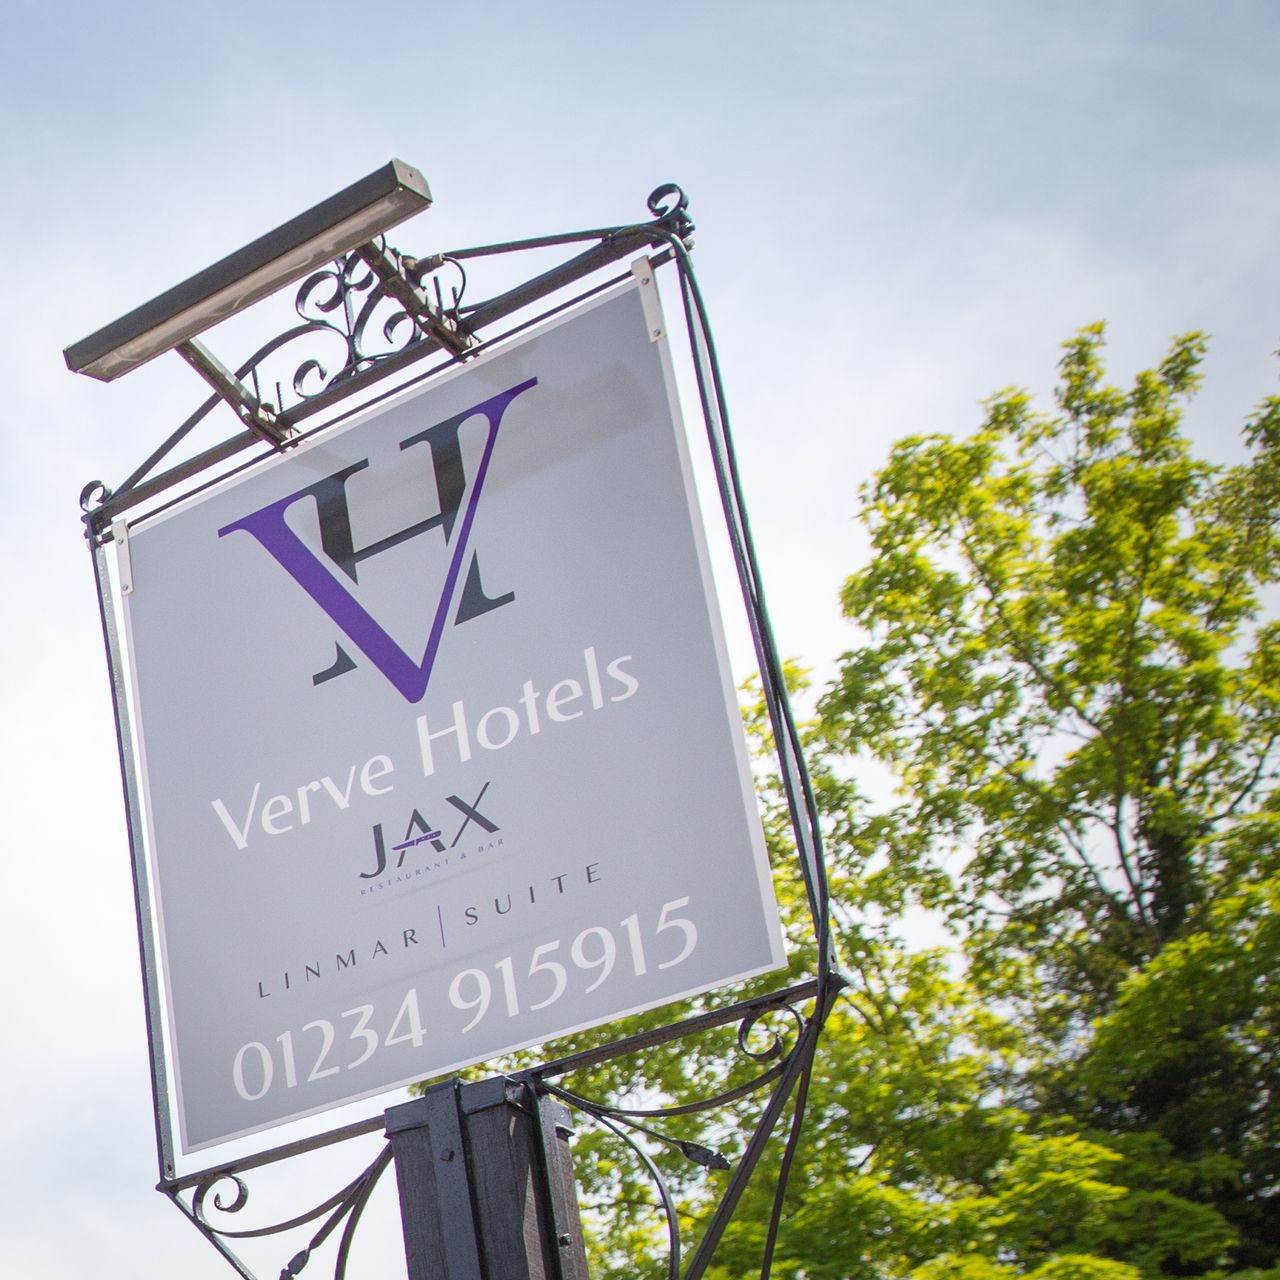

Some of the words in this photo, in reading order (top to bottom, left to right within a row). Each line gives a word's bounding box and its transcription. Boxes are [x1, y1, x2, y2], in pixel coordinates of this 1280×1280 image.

[211, 753, 396, 850] Verve
[415, 646, 640, 777] Hotels
[359, 778, 501, 879] JAX
[360, 857, 450, 896] RESTAURANT
[477, 838, 505, 853] BAR
[232, 988, 428, 1102] 01234
[448, 895, 700, 1034] 915915
[257, 928, 420, 999] LINMAR
[464, 862, 602, 926] SUITE
